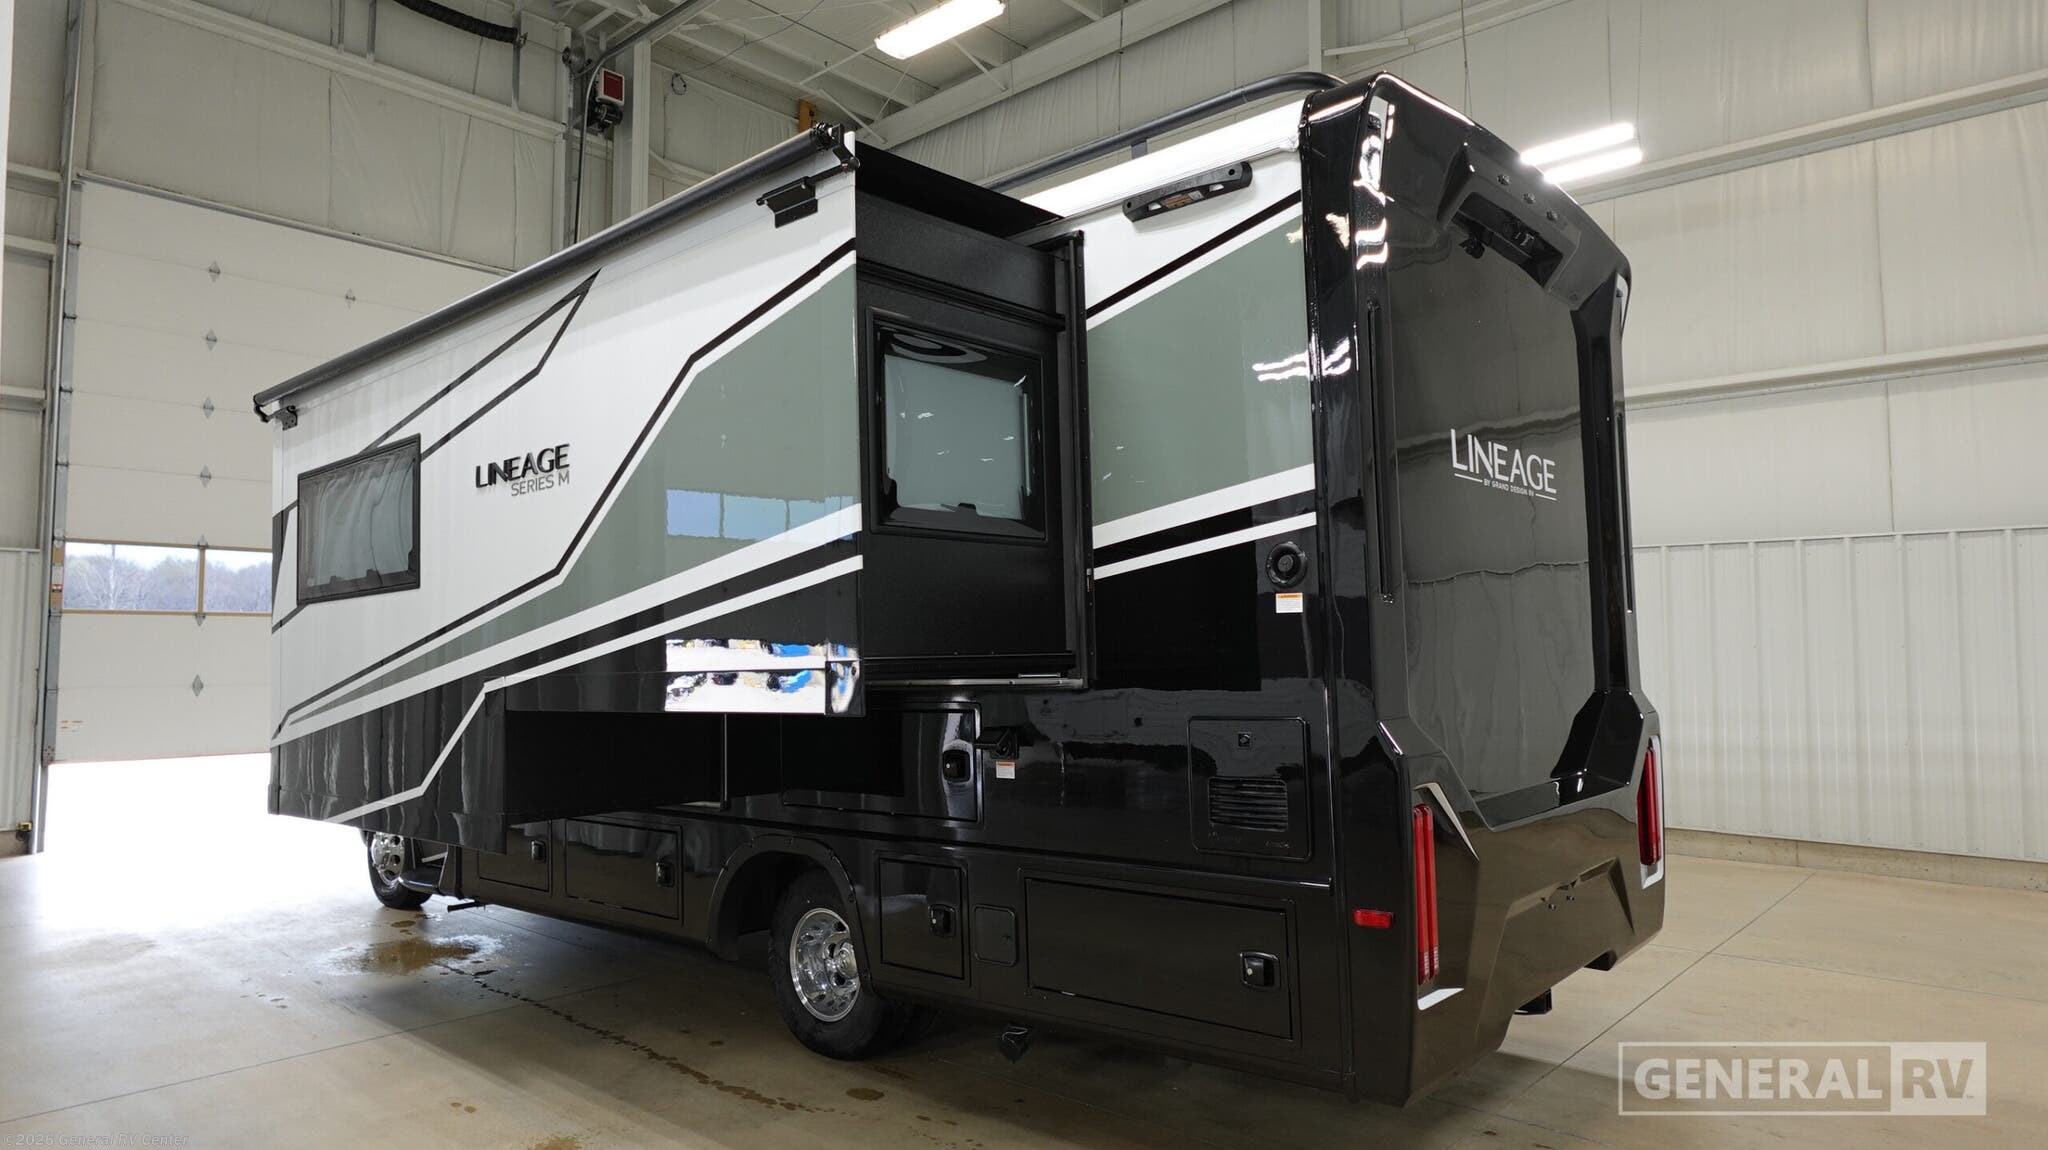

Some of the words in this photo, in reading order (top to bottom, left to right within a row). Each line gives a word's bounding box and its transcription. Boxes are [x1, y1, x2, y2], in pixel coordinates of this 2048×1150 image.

[475, 443, 570, 488] LINEAGE
[1450, 428, 1557, 494] LINEAGE
[511, 474, 554, 496] SERIES
[558, 470, 570, 486] M
[1483, 478, 1491, 486] BY
[1491, 480, 1509, 491] GRAND
